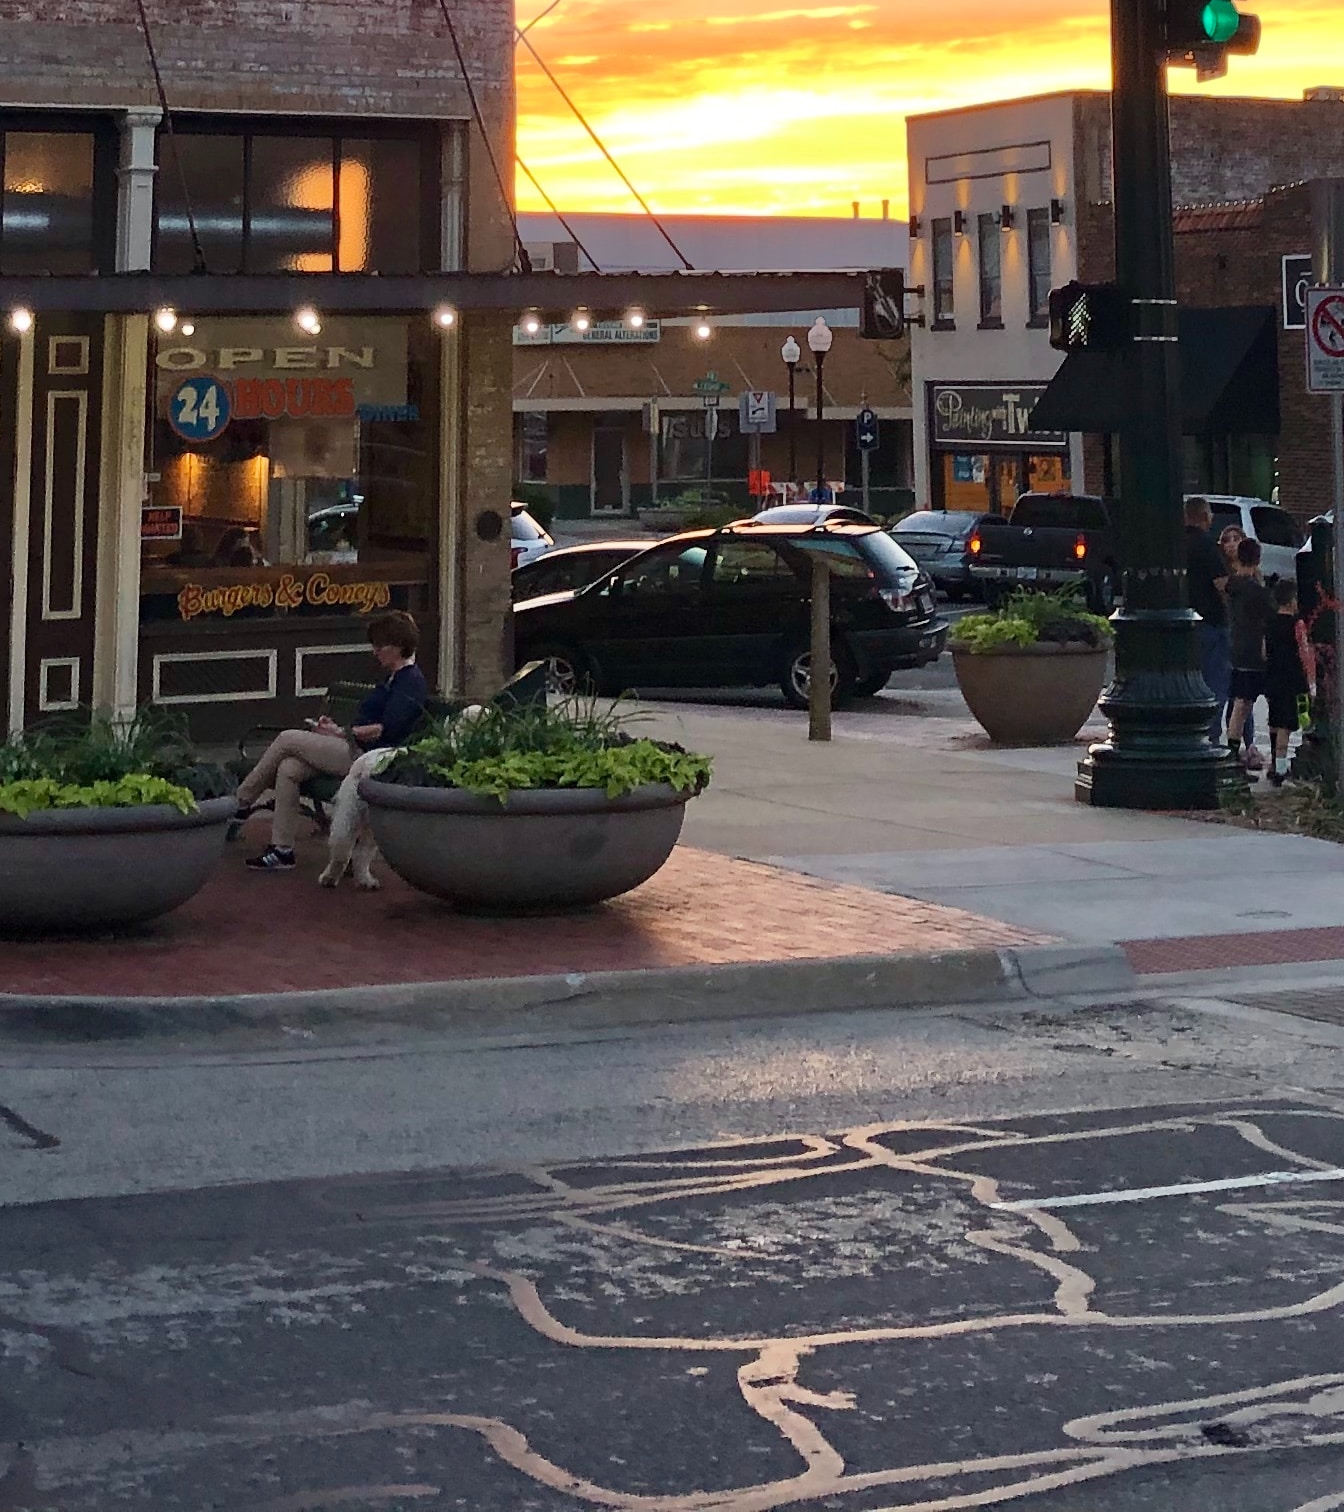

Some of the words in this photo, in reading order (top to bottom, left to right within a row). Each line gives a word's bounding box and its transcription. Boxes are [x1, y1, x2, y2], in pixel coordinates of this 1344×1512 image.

[155, 345, 376, 370] OPEN
[177, 385, 221, 432] 24
[233, 377, 356, 418] HOURS
[862, 411, 873, 424] P
[177, 583, 274, 621] Burgers
[276, 574, 304, 606] &
[306, 573, 391, 614] Coneys
